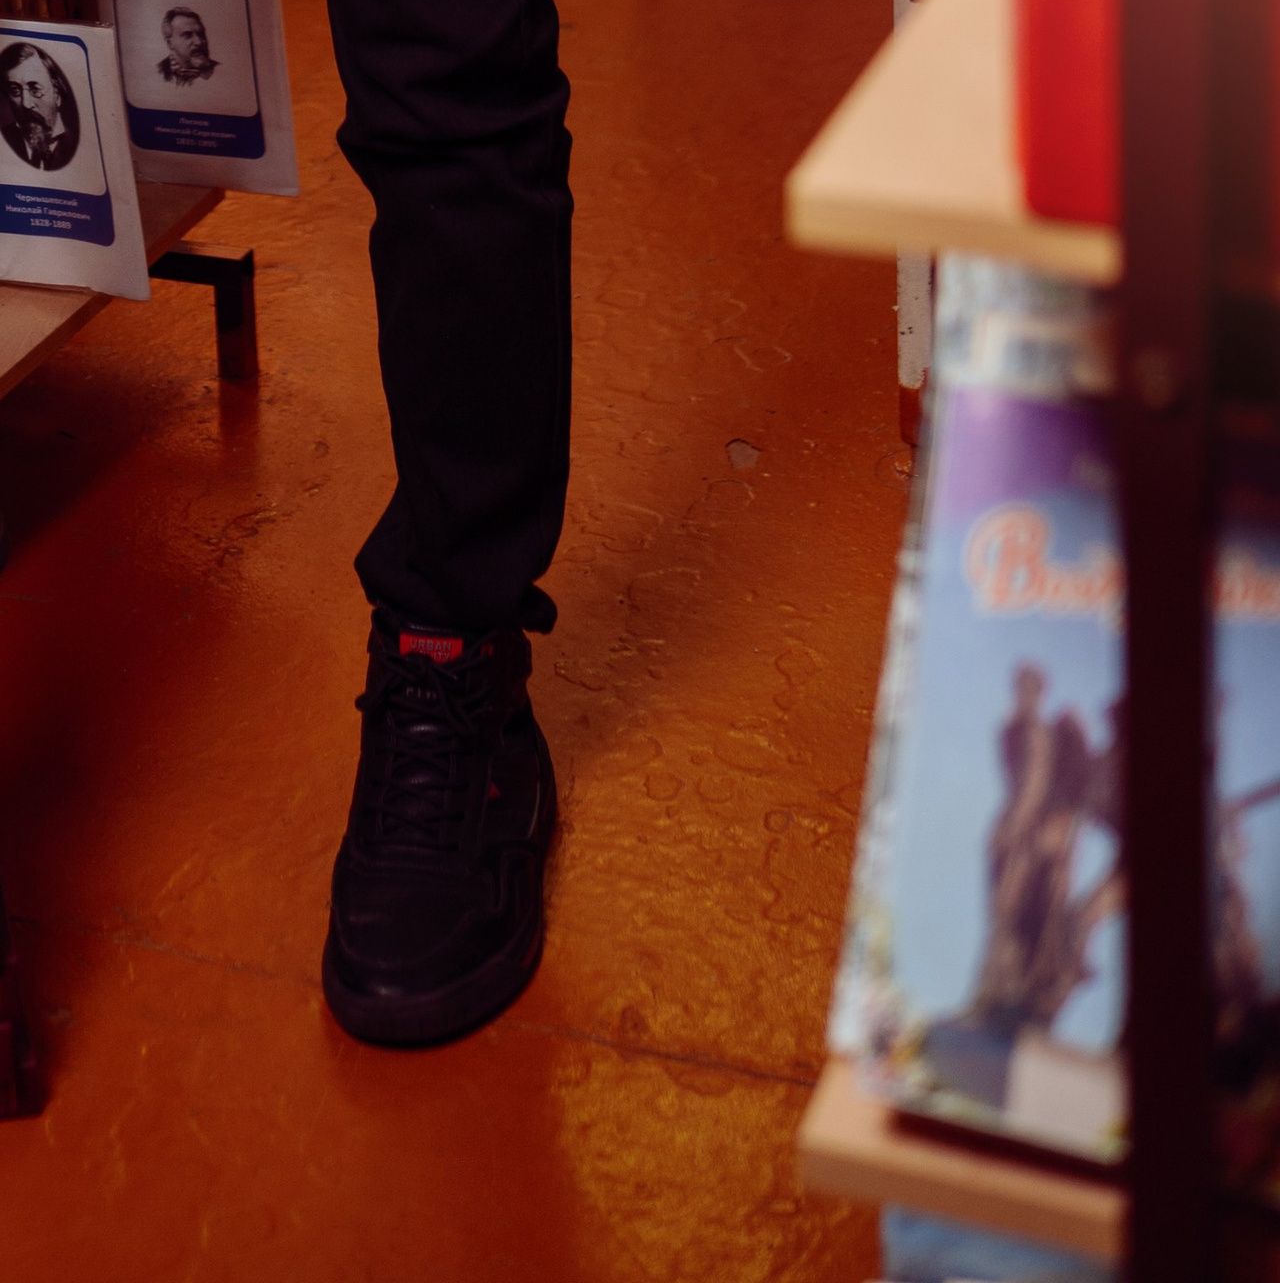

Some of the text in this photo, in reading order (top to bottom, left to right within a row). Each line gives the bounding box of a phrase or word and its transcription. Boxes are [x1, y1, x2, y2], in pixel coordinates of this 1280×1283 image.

[15, 193, 78, 207] Чернышевский
[5, 204, 42, 215] Николай
[410, 638, 453, 652] URBAN
